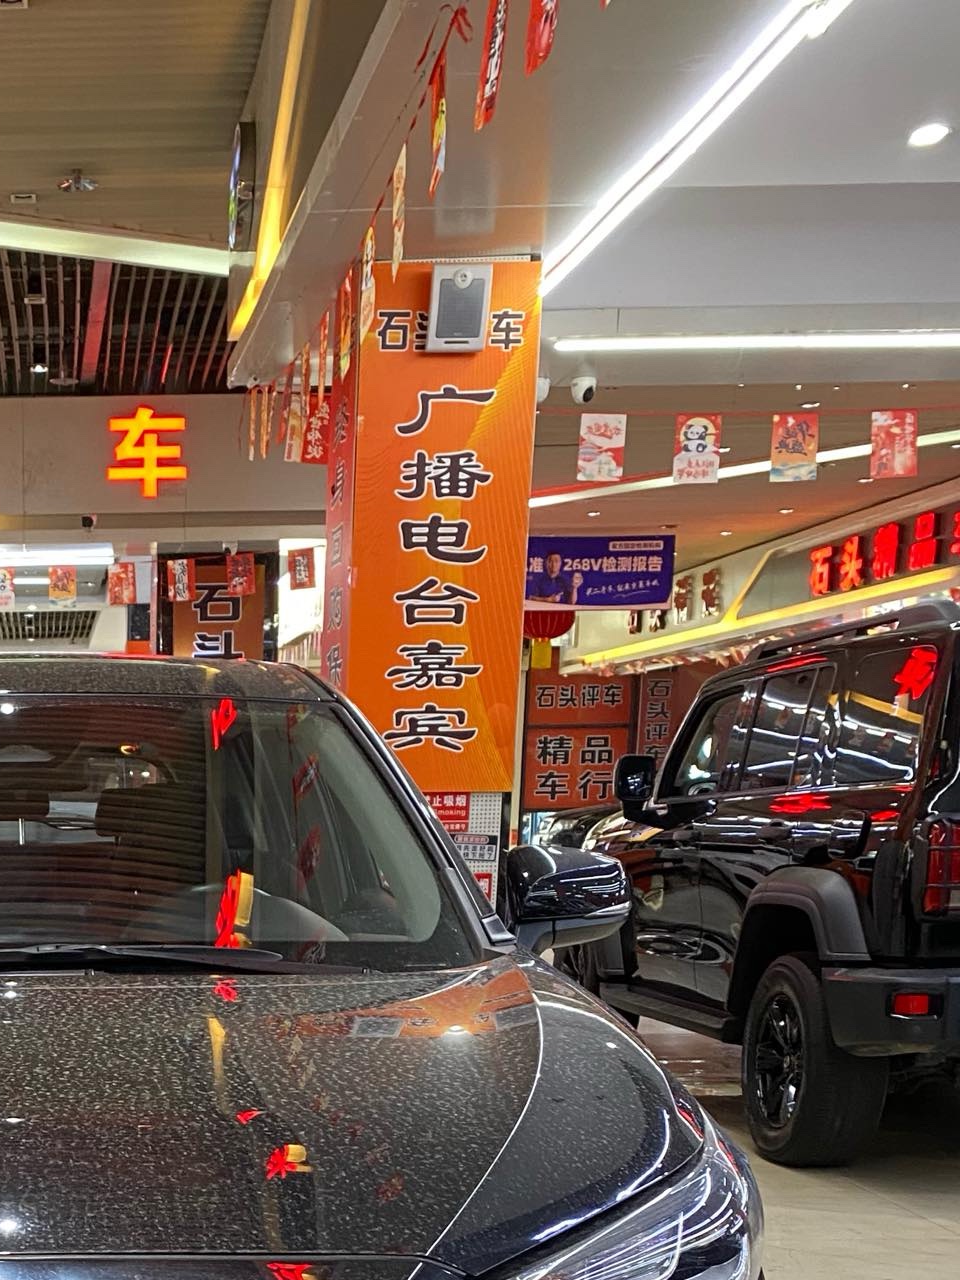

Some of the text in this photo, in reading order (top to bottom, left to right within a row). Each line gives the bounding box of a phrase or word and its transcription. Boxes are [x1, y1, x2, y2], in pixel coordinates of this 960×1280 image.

[382, 384, 497, 752] 广播电台嘉宾
[563, 556, 663, 572] 268V检测报告
[536, 684, 623, 710] 石头评车
[537, 734, 614, 766] 精品
[534, 770, 614, 802] 车行
